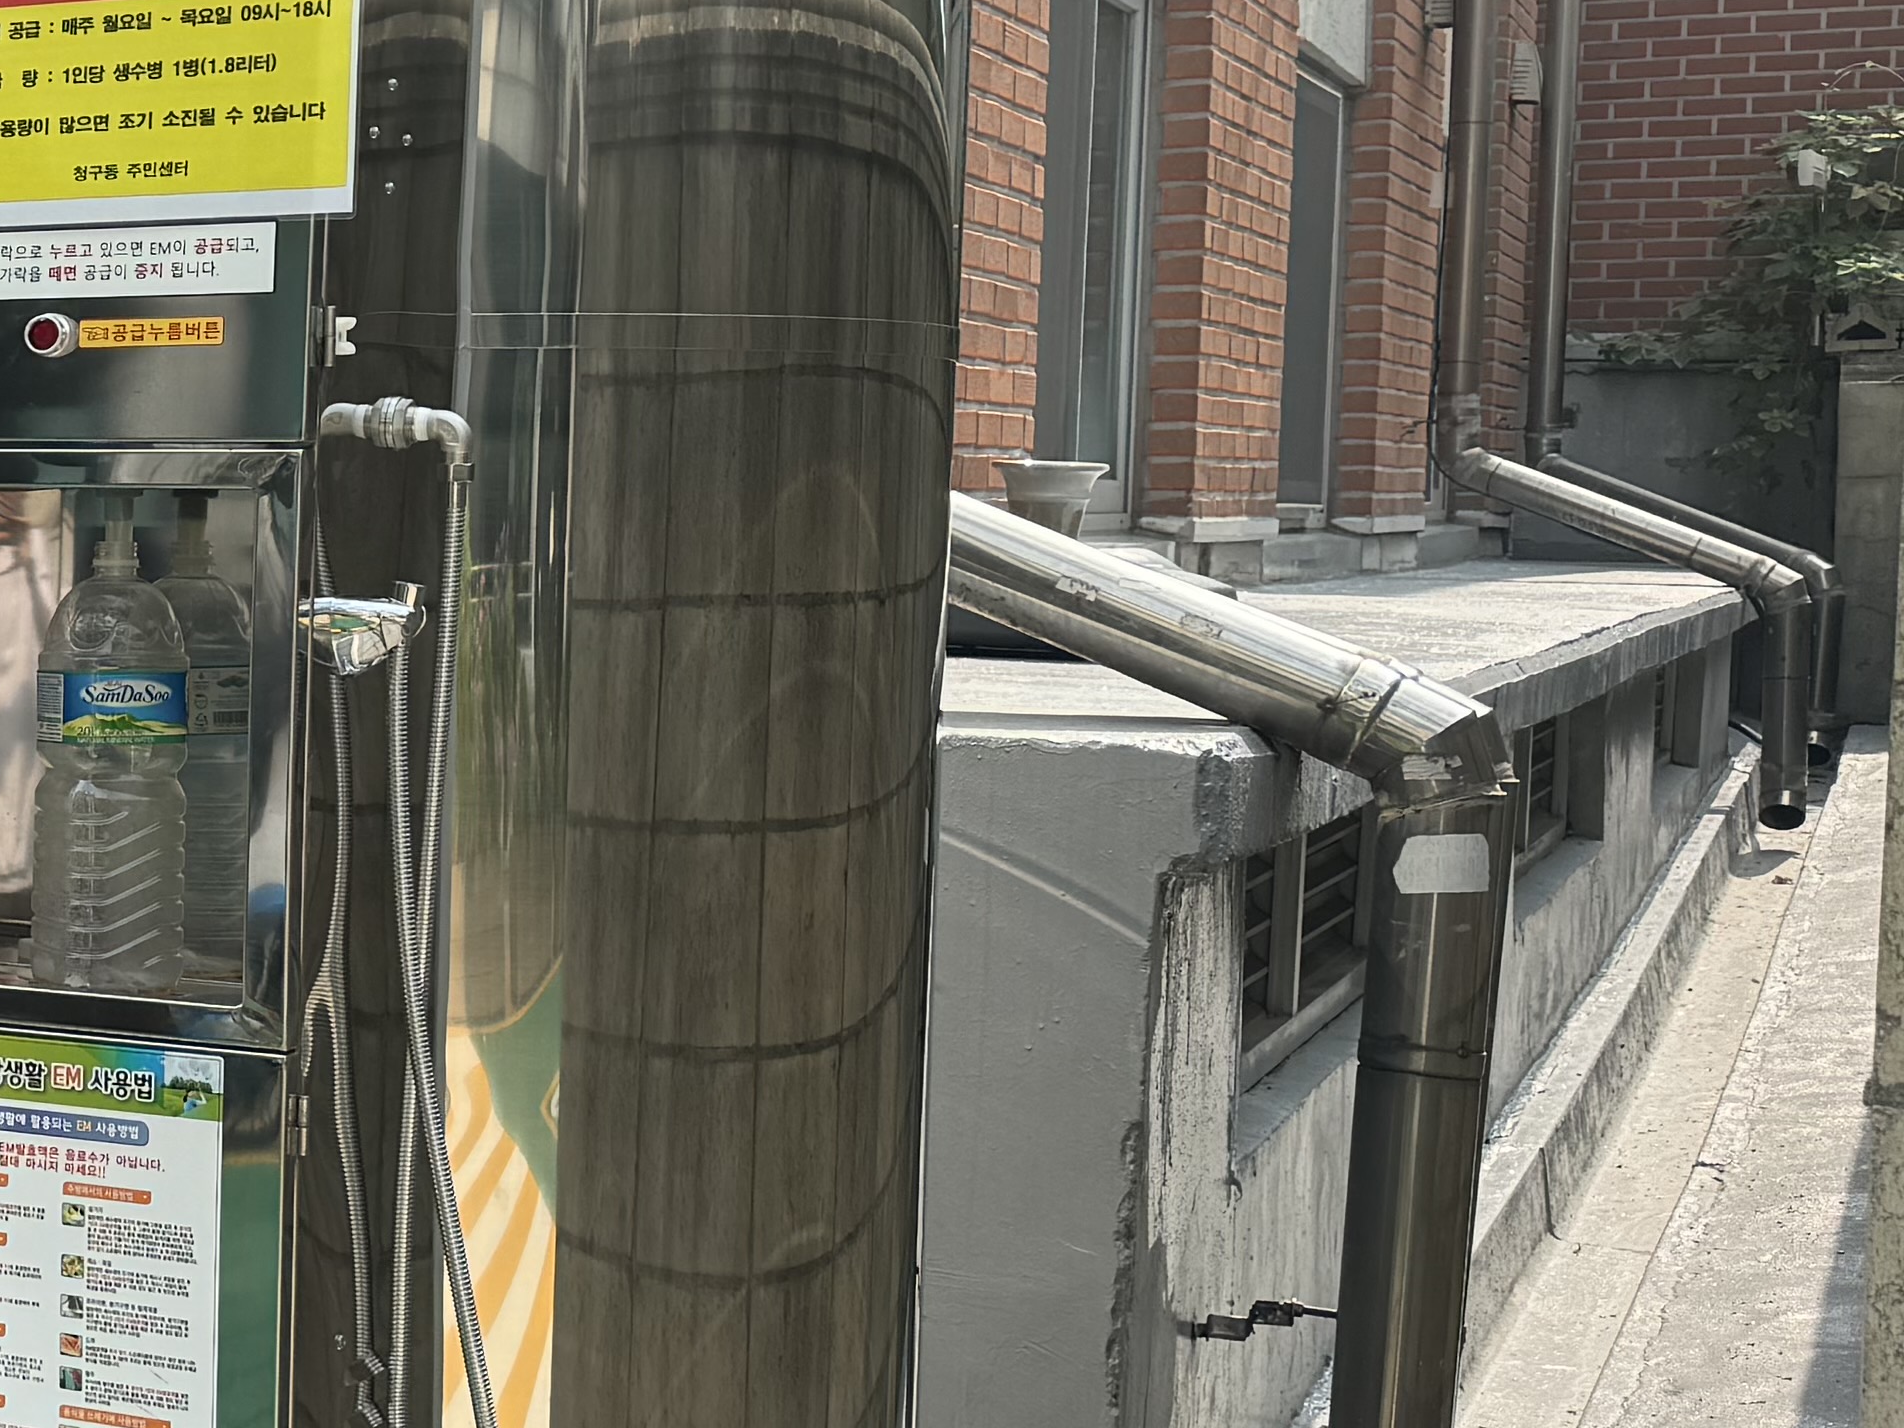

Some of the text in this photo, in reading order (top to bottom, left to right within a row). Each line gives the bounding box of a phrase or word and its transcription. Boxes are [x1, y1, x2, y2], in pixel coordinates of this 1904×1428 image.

[8, 20, 41, 40] 공급
[61, 16, 95, 37] 매주
[102, 12, 152, 33] 월요일
[180, 5, 232, 26] 목요일
[241, 0, 331, 22] 09시~18시
[62, 66, 104, 84] 1인당
[114, 61, 163, 83] 생수병
[172, 53, 277, 77] 1병(1.8리터)
[59, 113, 110, 134] 많으면
[118, 111, 153, 130] 조기
[162, 107, 215, 127] 소진될
[225, 107, 243, 125] 수
[253, 101, 326, 124] 있습니다
[73, 160, 189, 182] 청구동 주민센터
[49, 241, 93, 259] 누르고
[99, 240, 144, 258] 있으면
[149, 238, 187, 256] EM이
[193, 236, 260, 255] 공급되고,
[83, 263, 127, 281] 공급이
[134, 262, 164, 279] 중지
[170, 260, 220, 279] 됩니다.
[111, 320, 221, 343] 공급누름버튼
[82, 684, 169, 704] SamDaSoo
[51, 1062, 83, 1090] EM
[89, 1067, 156, 1102] 사용법
[31, 1114, 73, 1133] 활용되는
[76, 1120, 91, 1132] EM
[95, 1122, 140, 1140] 사용방법
[26, 1158, 60, 1173] 마시지
[65, 1148, 110, 1166] 음료수가
